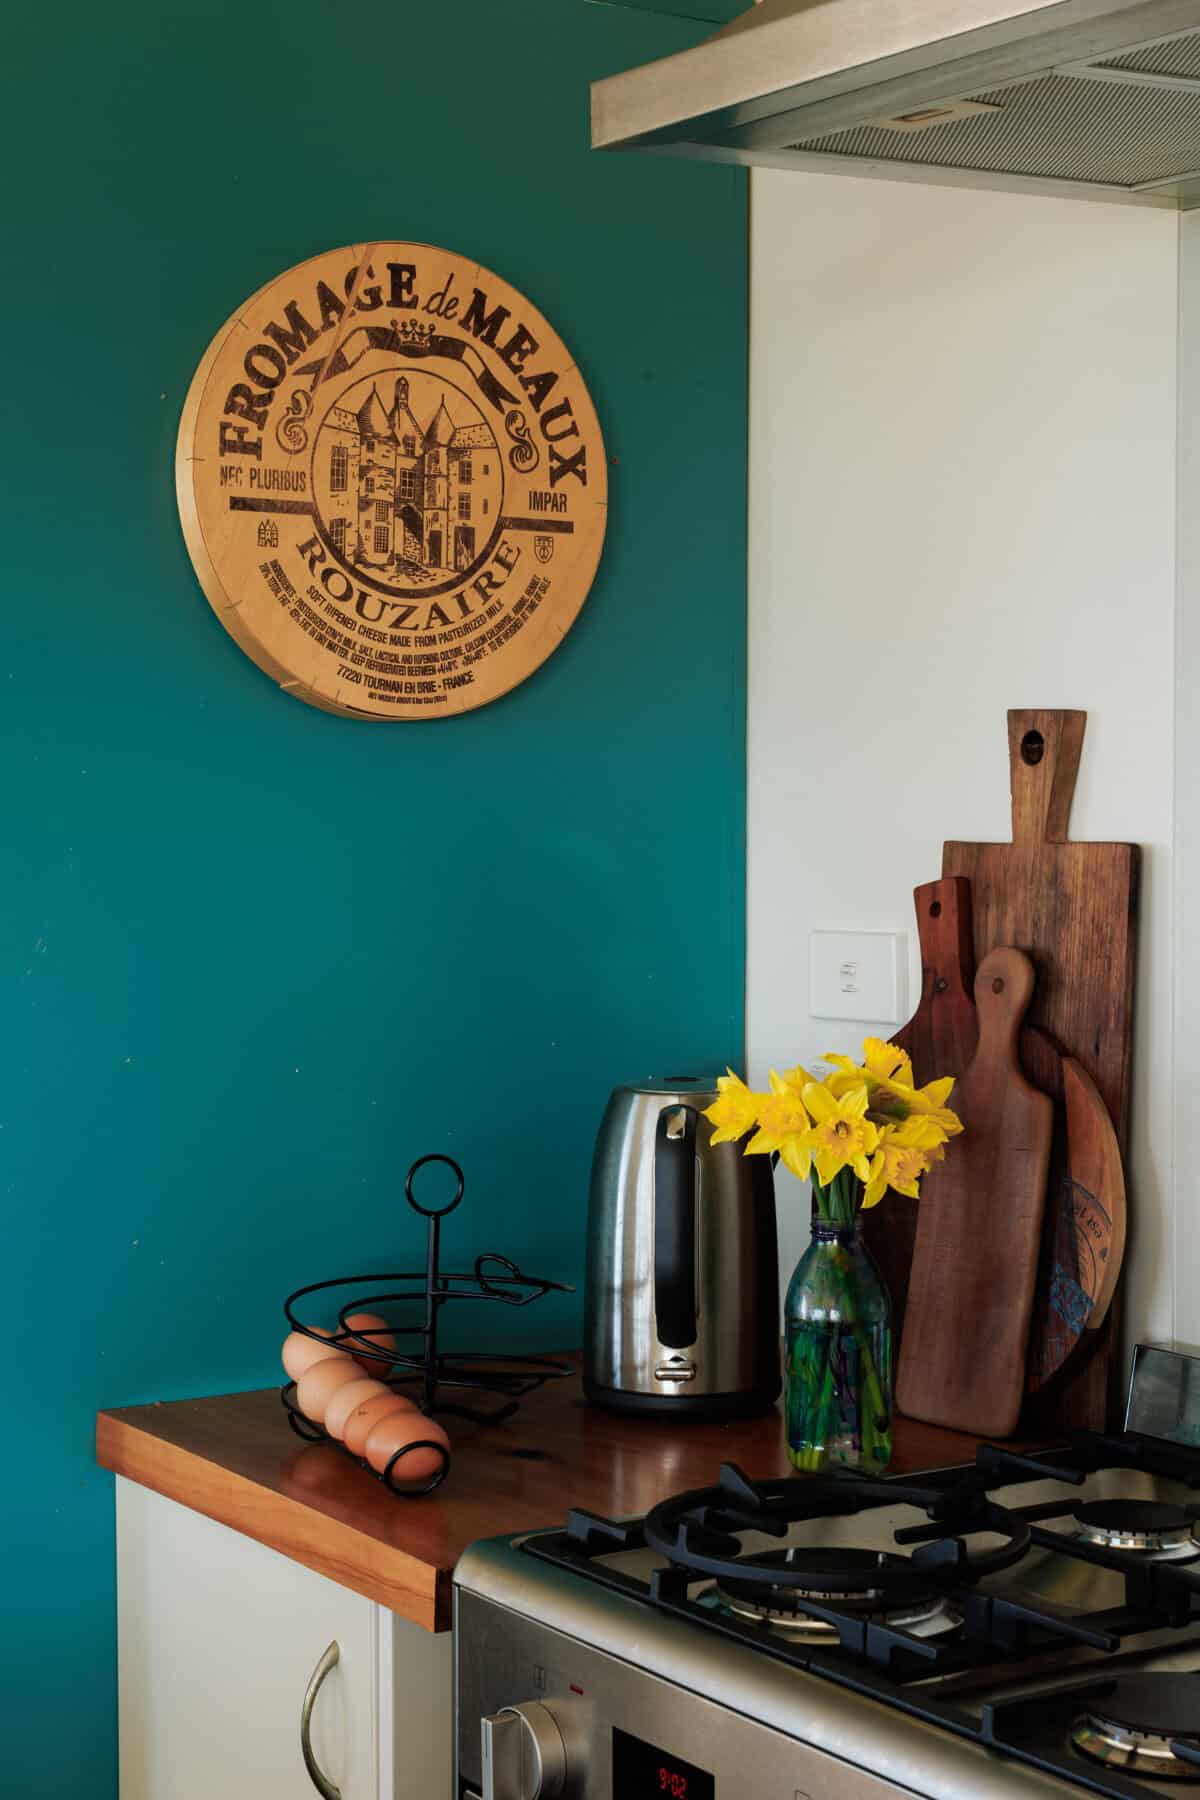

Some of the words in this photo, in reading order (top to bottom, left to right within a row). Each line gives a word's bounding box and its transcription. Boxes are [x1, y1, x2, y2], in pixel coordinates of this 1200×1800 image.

[219, 262, 419, 460] FROMAGE
[422, 272, 459, 320] de
[458, 288, 587, 488] MEAUX
[249, 467, 307, 492] PLURIBUS
[528, 490, 567, 513] IMPAR
[296, 533, 520, 630] ROUZAIRE
[306, 585, 327, 607] SOFT
[323, 602, 357, 631] RIPENED
[358, 624, 388, 644] CHEESE
[389, 634, 411, 648] MADE
[414, 635, 437, 648] FROM
[438, 614, 487, 644] PASTEURIZED
[486, 598, 504, 619] MILK
[337, 663, 362, 684] 77220
[363, 673, 403, 693] TOURNAN
[404, 681, 416, 694] EN
[416, 680, 437, 694] BRIE
[442, 670, 473, 690] FRANCE
[659, 1767, 688, 1800] 9:02
